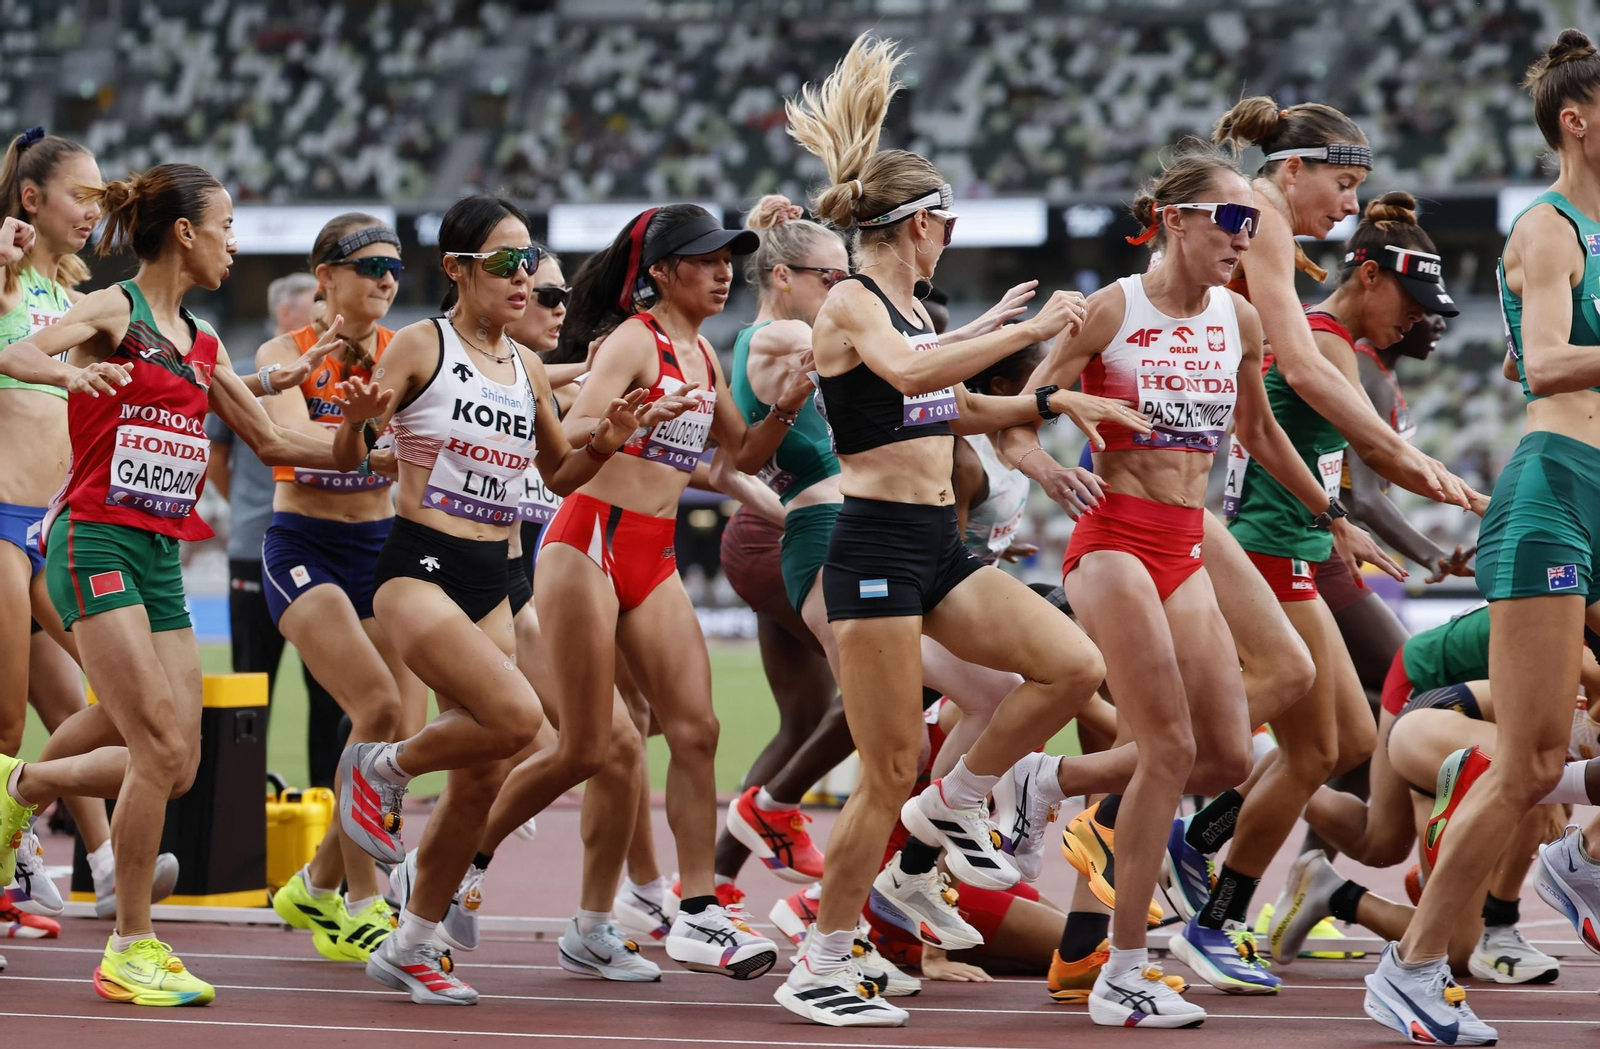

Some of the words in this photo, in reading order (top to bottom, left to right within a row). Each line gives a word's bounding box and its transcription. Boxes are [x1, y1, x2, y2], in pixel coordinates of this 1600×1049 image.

[1126, 328, 1163, 347] 4F
[1169, 346, 1198, 354] ORLEN
[1140, 374, 1236, 393] HONDA
[481, 387, 522, 408] Shinhan
[119, 403, 208, 438] MOROCC
[119, 432, 207, 463] HONDA
[445, 437, 532, 470] HONDA
[117, 459, 199, 495] GARDADI
[462, 470, 508, 502] LIM
[134, 496, 191, 514] TOKYO25
[453, 499, 514, 522] TOKYO25
